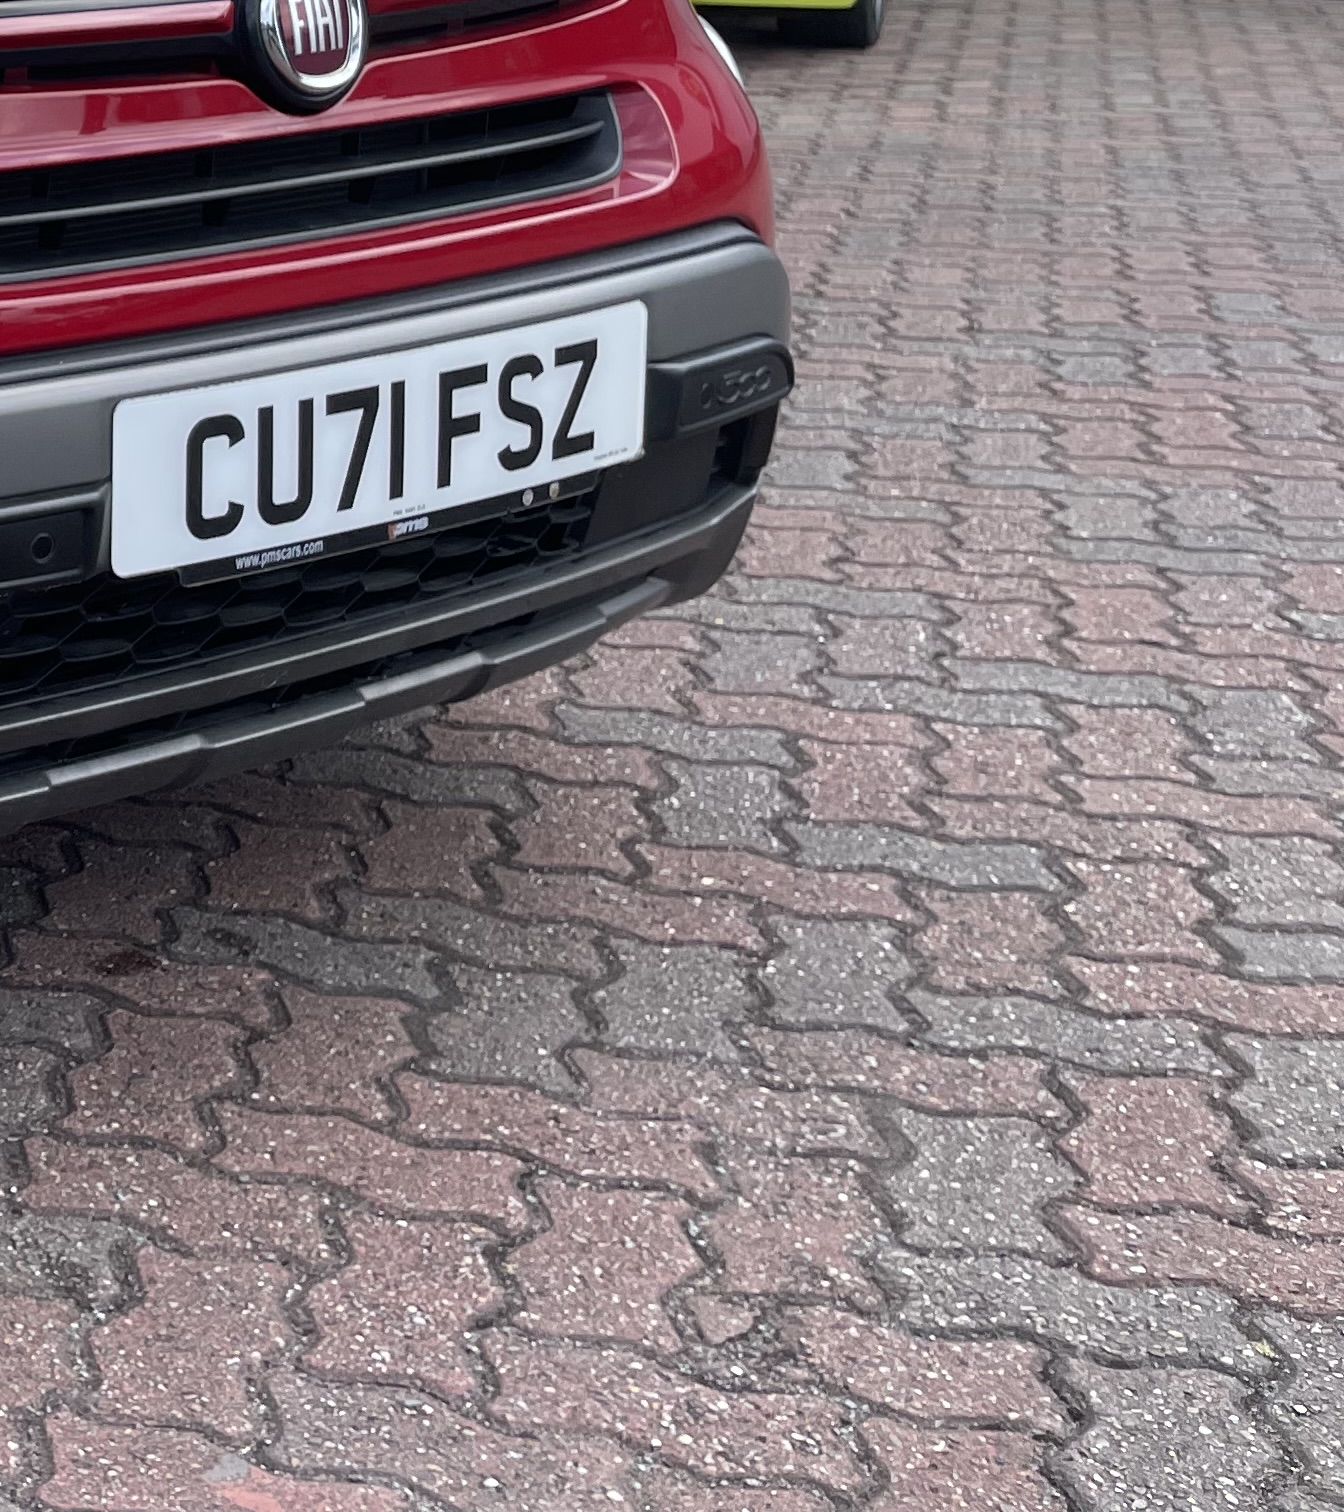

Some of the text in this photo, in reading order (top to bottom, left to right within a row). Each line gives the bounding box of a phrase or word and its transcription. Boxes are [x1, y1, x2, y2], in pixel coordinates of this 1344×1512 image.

[185, 338, 599, 541] CU71 FSZ
[234, 539, 324, 570] www.pmscars.com
